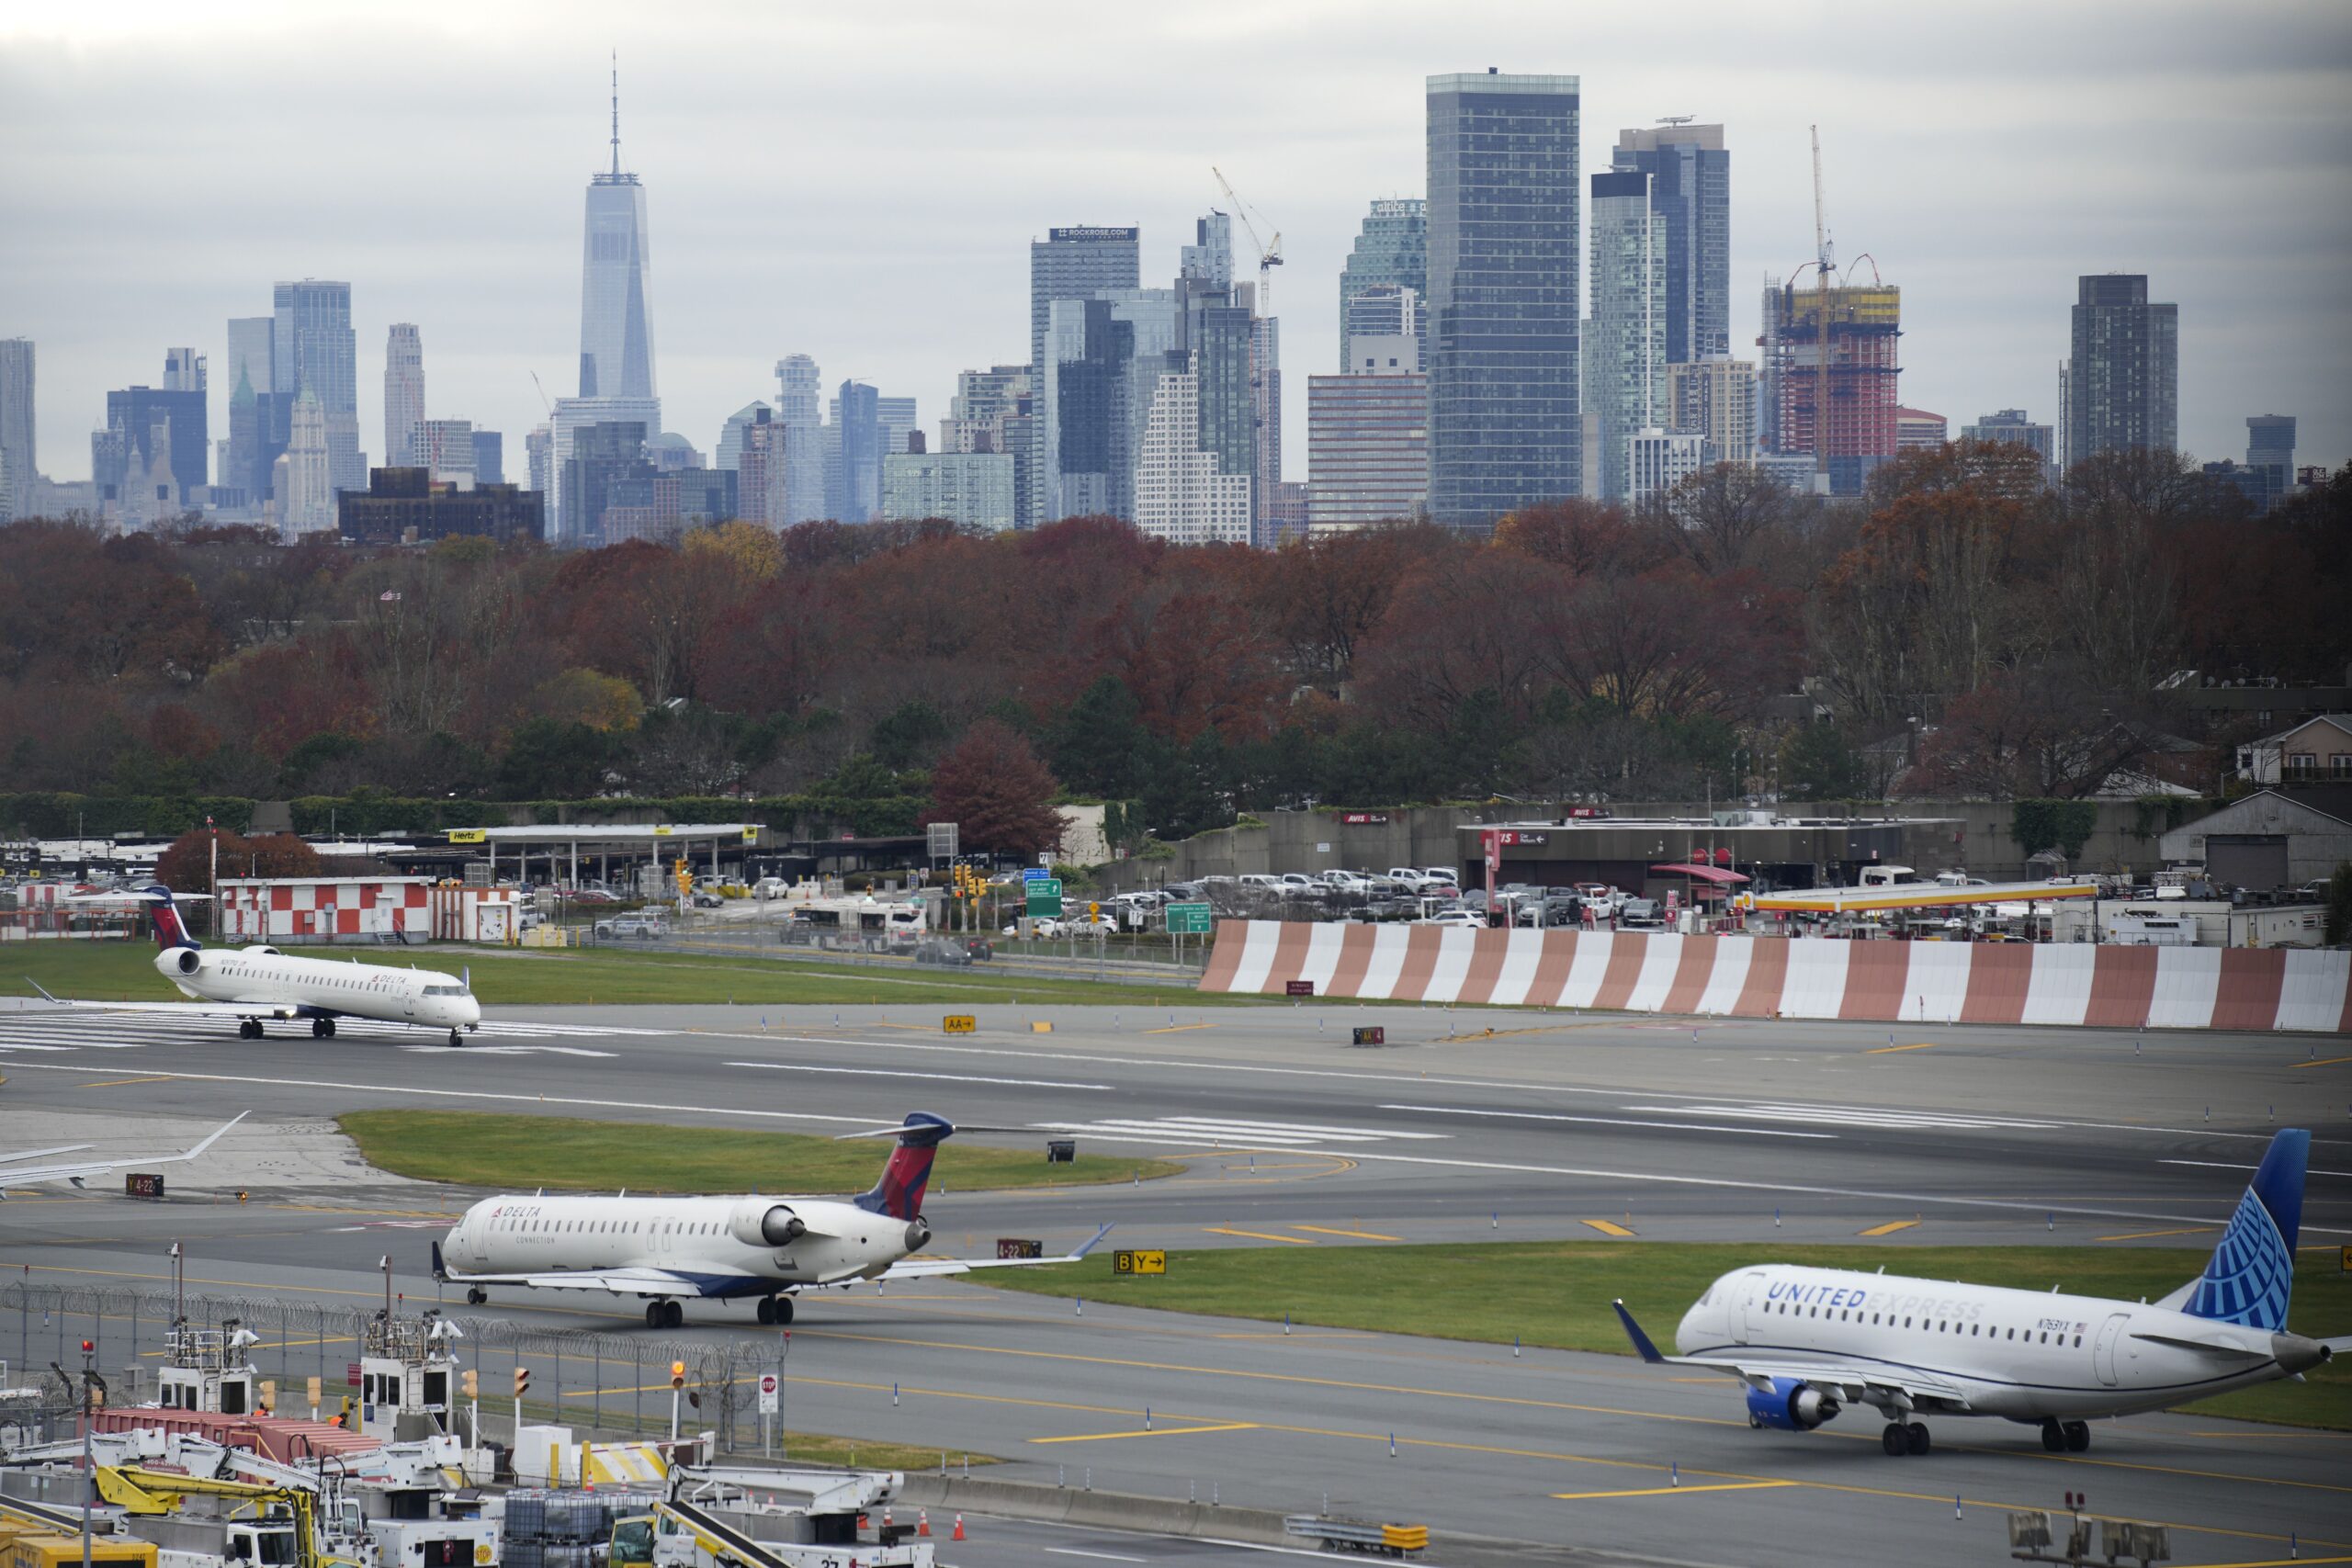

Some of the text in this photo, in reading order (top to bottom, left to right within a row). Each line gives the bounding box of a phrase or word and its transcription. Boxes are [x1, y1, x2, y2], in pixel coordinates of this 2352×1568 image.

[1377, 200, 1405, 212] altice
[1348, 815, 1365, 823] AVIS
[380, 976, 407, 986] DELTA
[948, 1019, 963, 1030] AA
[1363, 1030, 1382, 1042] AA 4
[129, 1178, 153, 1193] Y 4-22
[503, 1206, 540, 1218] DELTA
[1000, 1244, 1020, 1258] 4-22
[1119, 1255, 1147, 1269] B Y
[1769, 1281, 1984, 1321] UNITED EXPRESS
[477, 1548, 492, 1559] STOP
